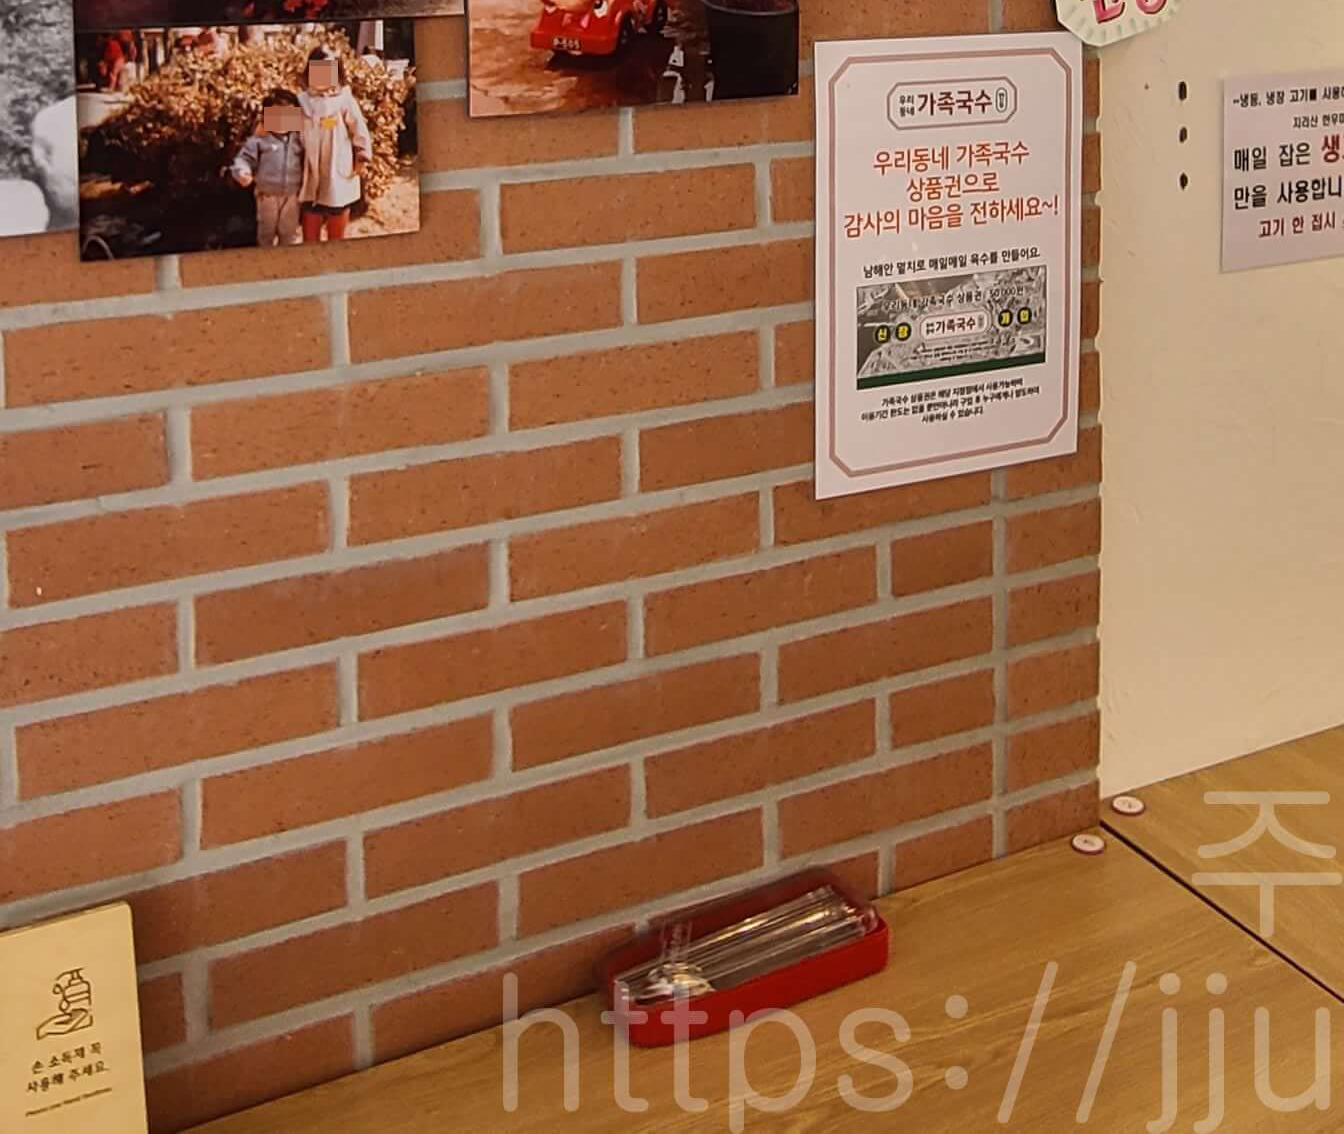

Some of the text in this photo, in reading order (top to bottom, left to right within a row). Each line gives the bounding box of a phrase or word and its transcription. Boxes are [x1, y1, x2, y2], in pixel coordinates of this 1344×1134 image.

[917, 89, 993, 116] 가족국수
[1289, 87, 1318, 104] 고기를
[873, 140, 1030, 176] 우리동네 가족국수
[1233, 145, 1268, 173] 매일
[1278, 141, 1312, 168] 잡은
[906, 172, 1000, 203] 상품권으로
[1233, 184, 1268, 211] 만을
[843, 209, 901, 239] 감사의
[908, 204, 964, 231] 마음을
[1258, 219, 1286, 239] 고기
[1291, 215, 1305, 235] 한
[1311, 209, 1337, 232] 접시
[863, 261, 894, 278] 남해안
[896, 257, 927, 275] 멸치로
[928, 254, 968, 272] 매일매일
[970, 250, 999, 267] 육수를
[31, 1060, 44, 1075] 손
[26, 1073, 64, 1092] 사용해
